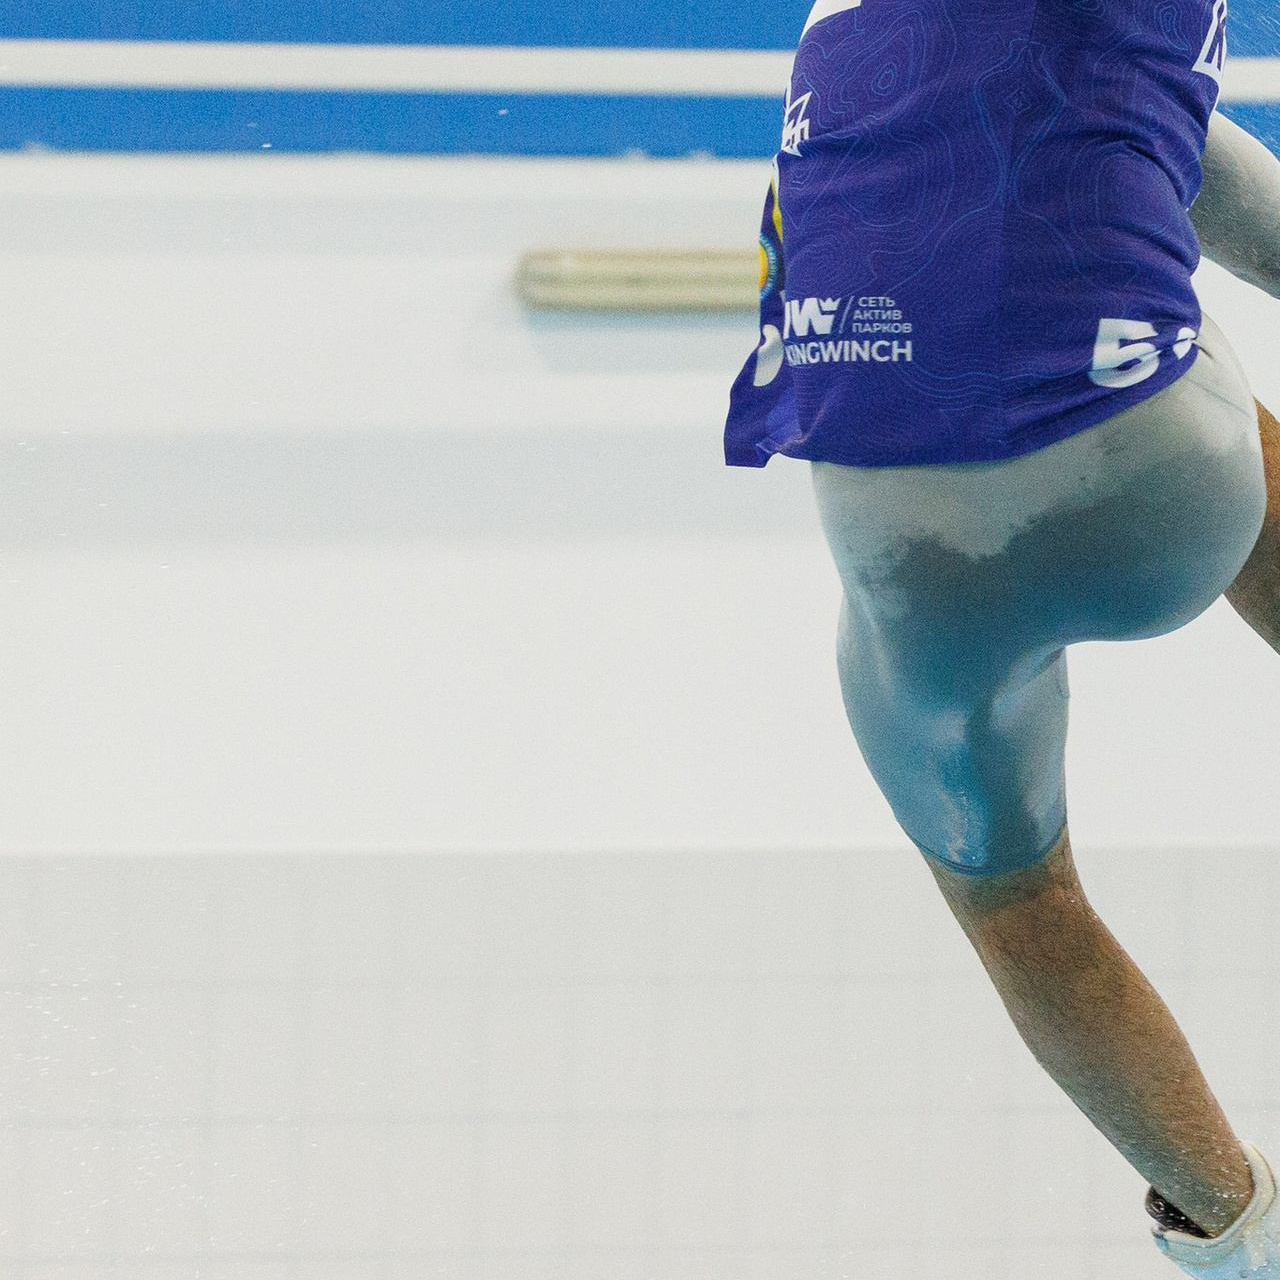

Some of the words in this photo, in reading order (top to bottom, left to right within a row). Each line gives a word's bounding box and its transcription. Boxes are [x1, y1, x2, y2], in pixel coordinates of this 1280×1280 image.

[858, 296, 896, 307] СЕТЬ
[853, 309, 903, 321] АКТИВ
[851, 322, 913, 334] ПАРКОВ
